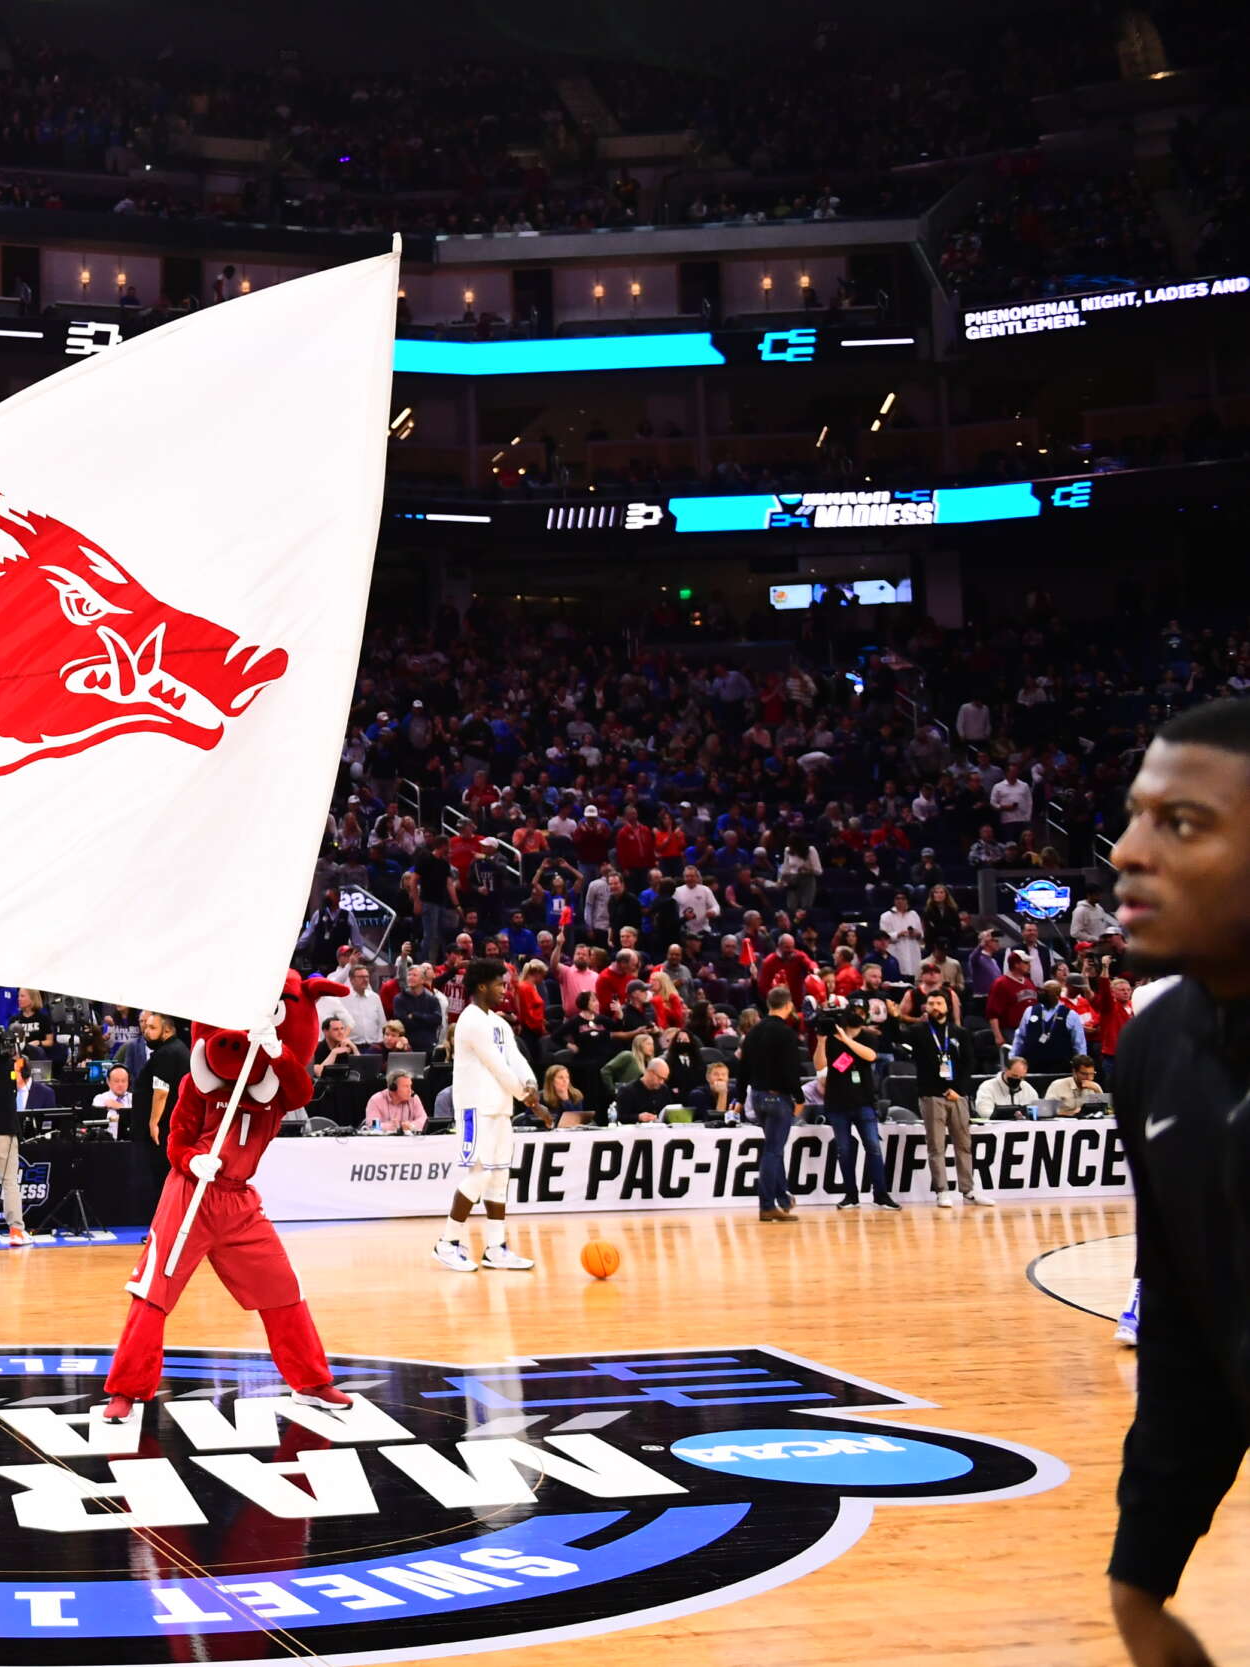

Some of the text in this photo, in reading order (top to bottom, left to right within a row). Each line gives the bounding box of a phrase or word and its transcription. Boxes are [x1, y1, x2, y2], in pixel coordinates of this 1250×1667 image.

[964, 276, 1250, 327] PHENOMENAL NIGHT, LADIES AND
[964, 313, 1086, 340] GENTLEMEN.
[813, 502, 934, 529] MADNESS
[350, 1163, 423, 1181] HOSTED
[427, 1162, 452, 1180] BY
[509, 1141, 571, 1203] HE
[586, 1138, 763, 1200] PAC-12
[671, 1436, 907, 1463] NCAA
[152, 1548, 580, 1624] SWEET
